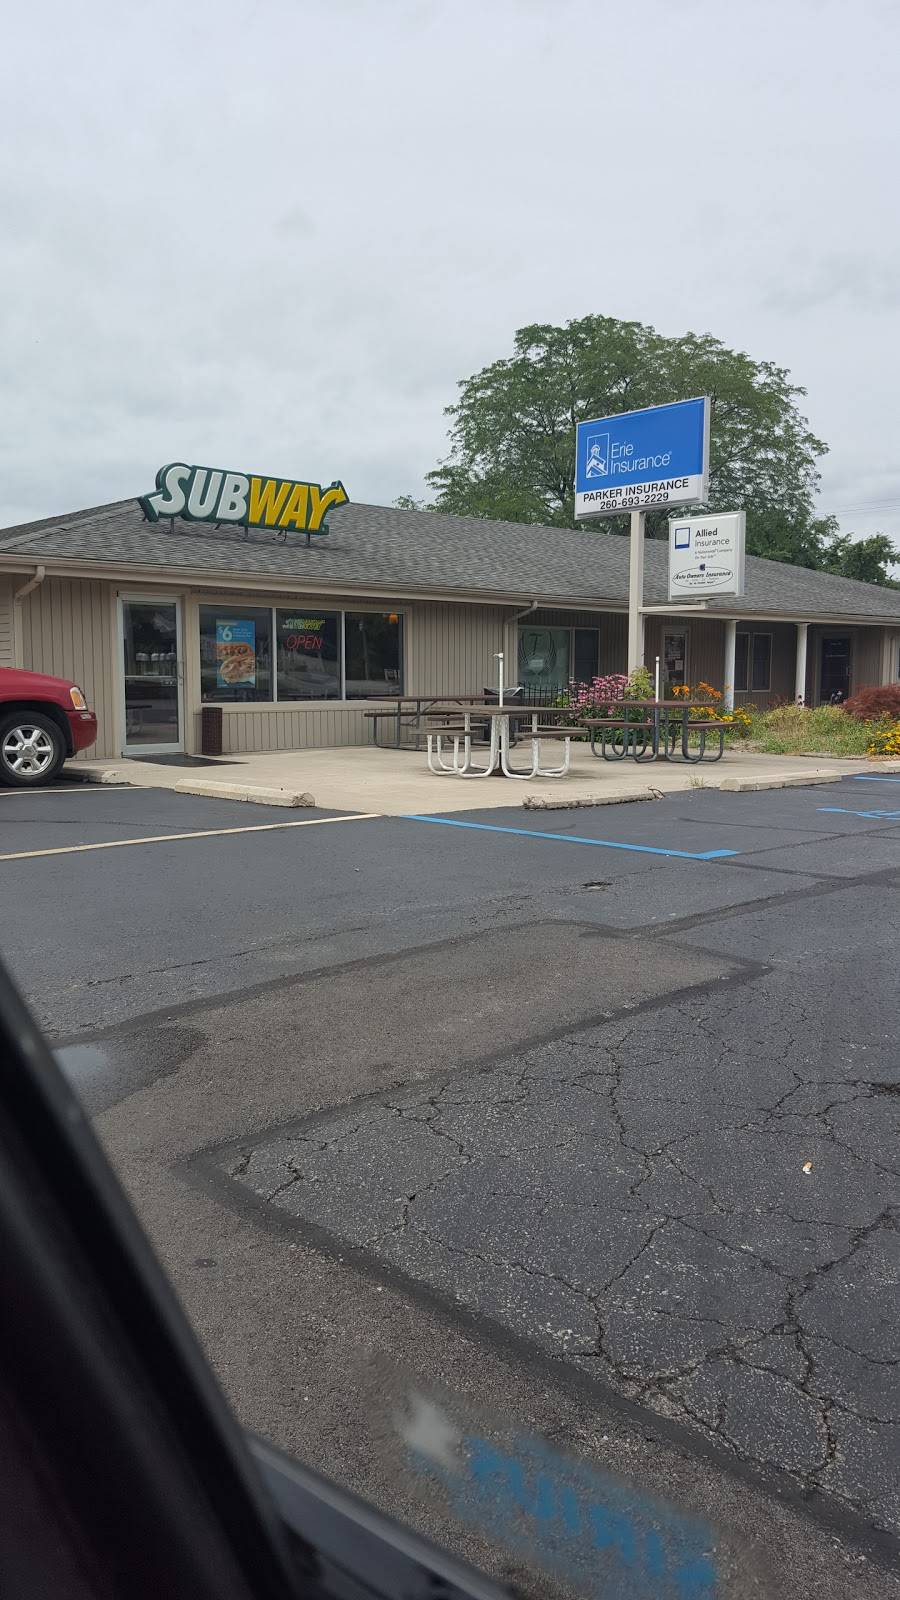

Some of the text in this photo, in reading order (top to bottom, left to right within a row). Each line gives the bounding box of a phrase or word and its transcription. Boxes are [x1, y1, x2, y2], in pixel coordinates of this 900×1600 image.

[611, 442, 634, 459] Erie
[148, 465, 347, 531] SUBWAY
[583, 478, 689, 503] PARKER INSURANCE
[600, 492, 669, 510] 260-693-2229
[695, 528, 718, 538] Allied
[695, 538, 730, 547] Insurance
[286, 634, 322, 650] OPEN
